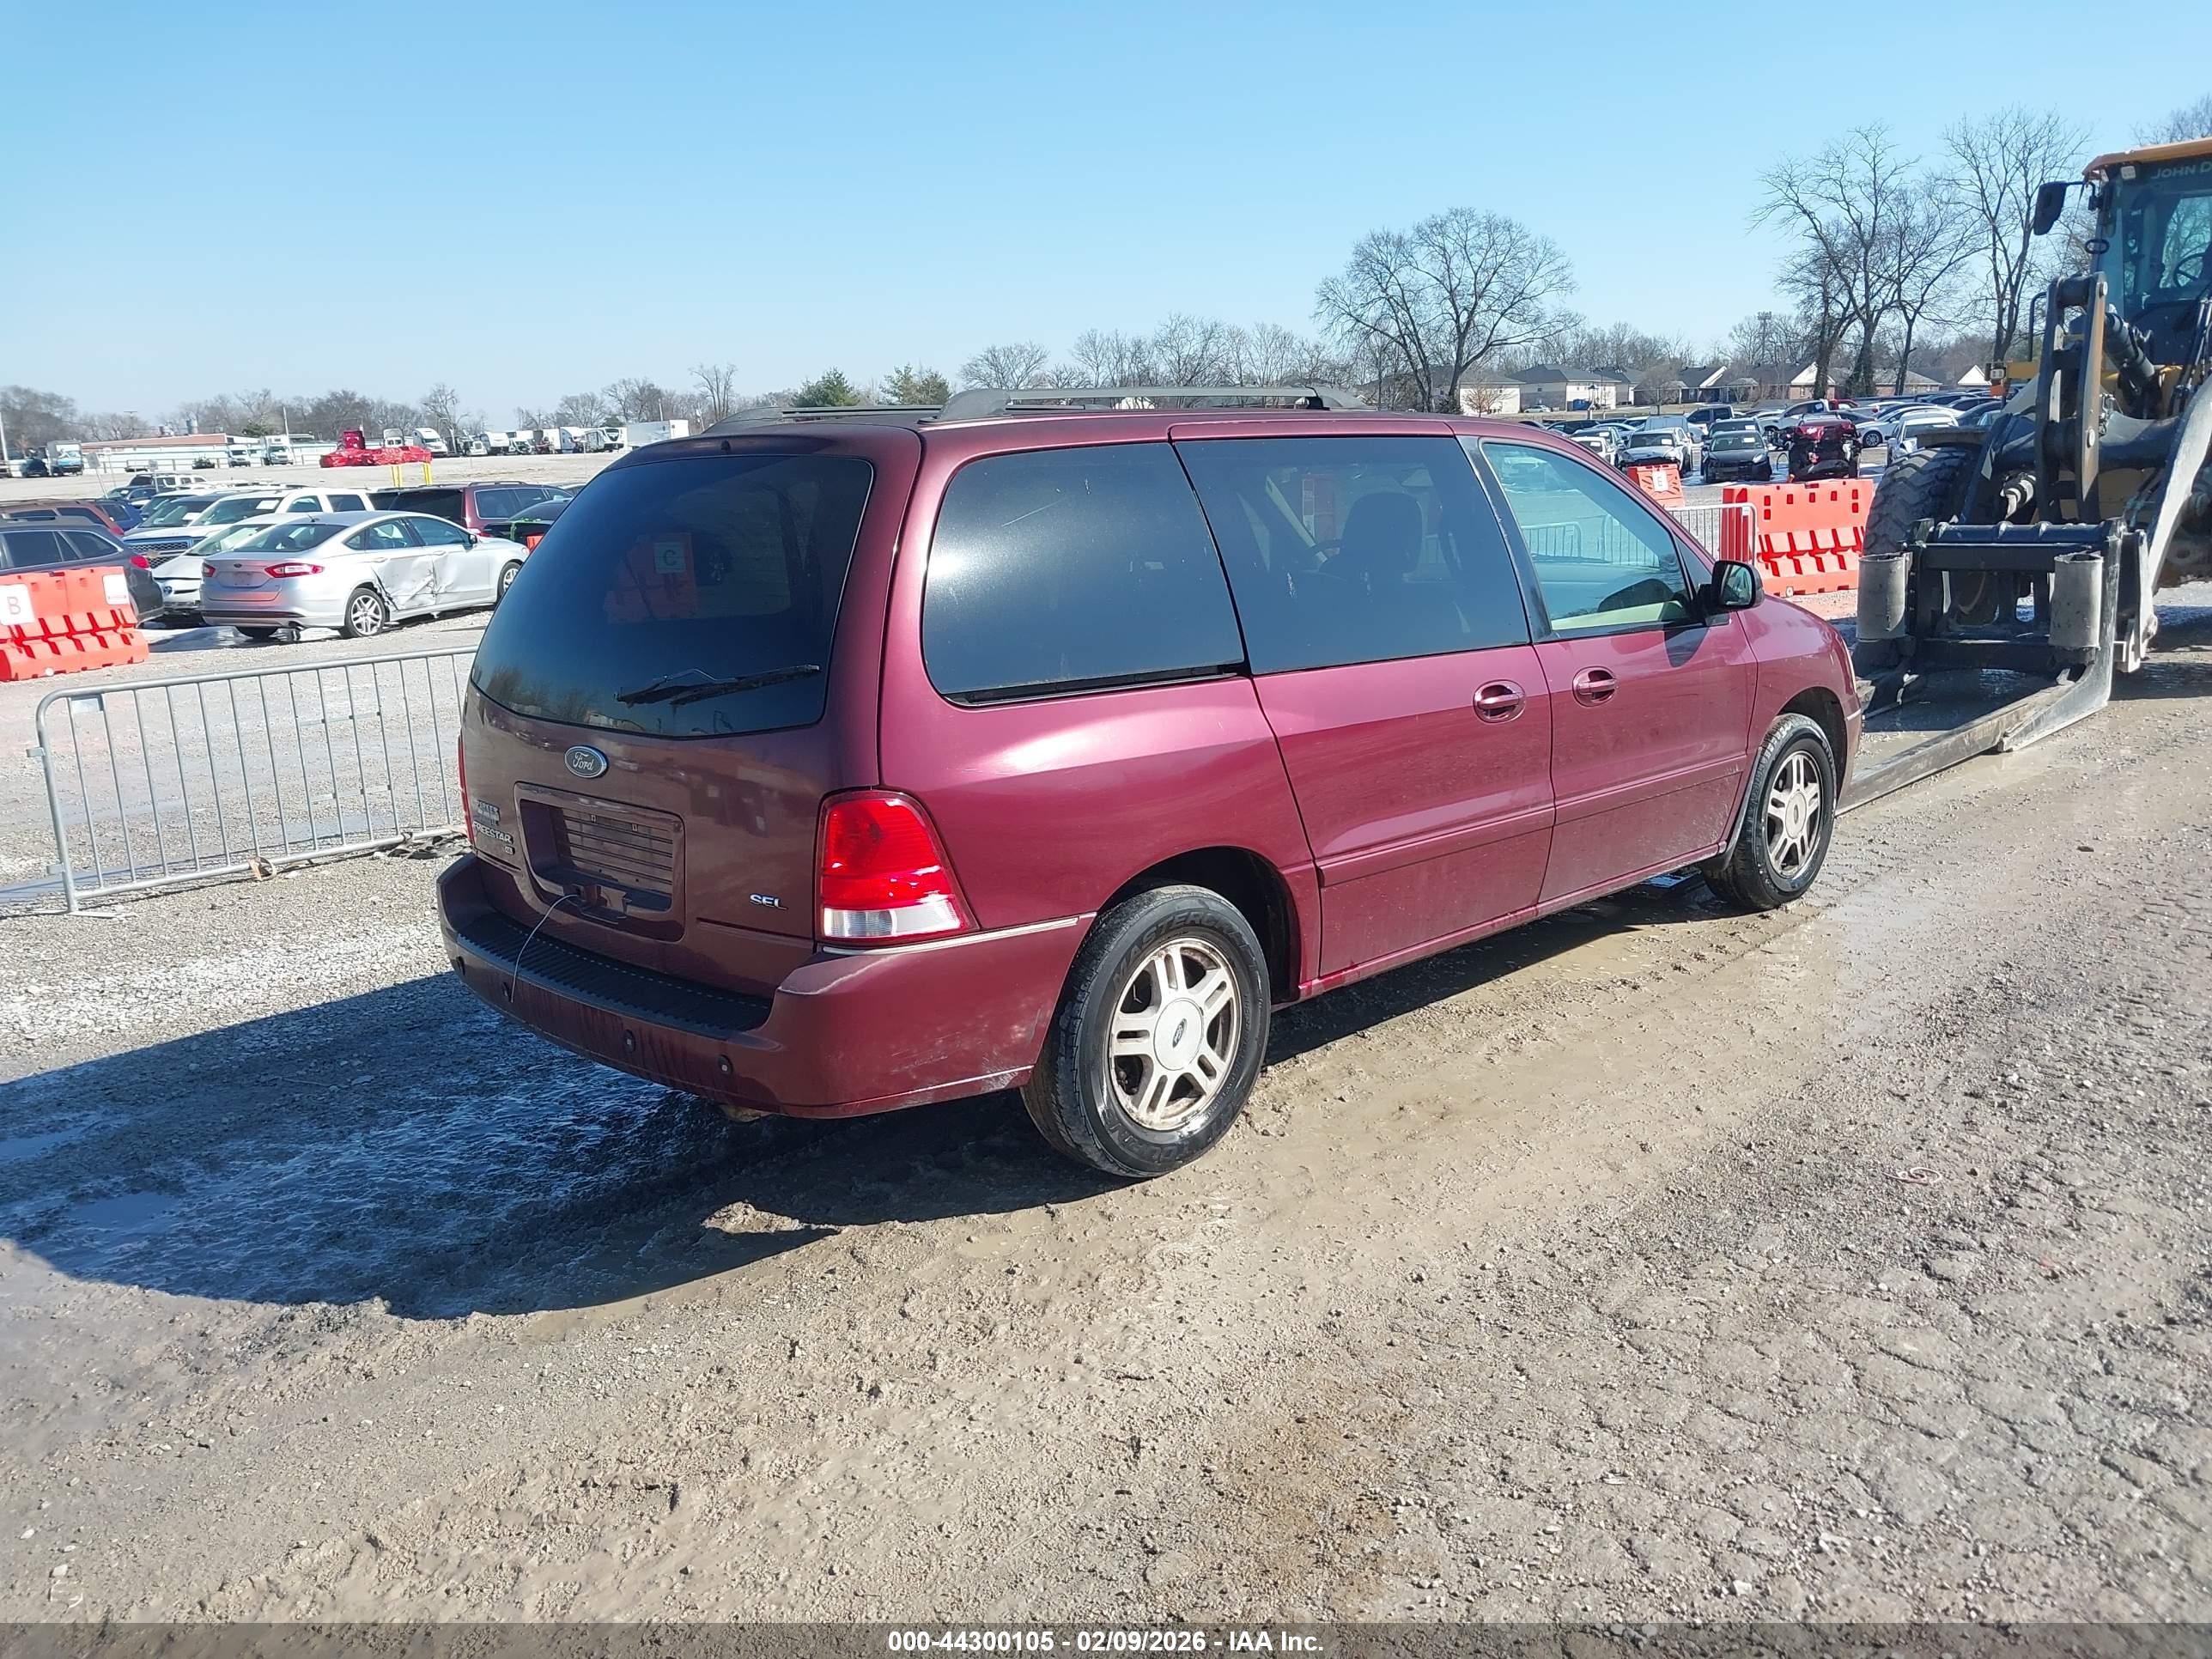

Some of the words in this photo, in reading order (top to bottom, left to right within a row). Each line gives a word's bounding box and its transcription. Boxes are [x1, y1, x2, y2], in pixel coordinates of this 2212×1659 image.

[2149, 164, 2197, 179] JOHN
[1657, 477, 1663, 487] E
[662, 550, 676, 567] C
[7, 596, 21, 615] B
[573, 751, 595, 771] Ford
[473, 820, 513, 844] FREESTAR
[750, 894, 788, 910] SEL
